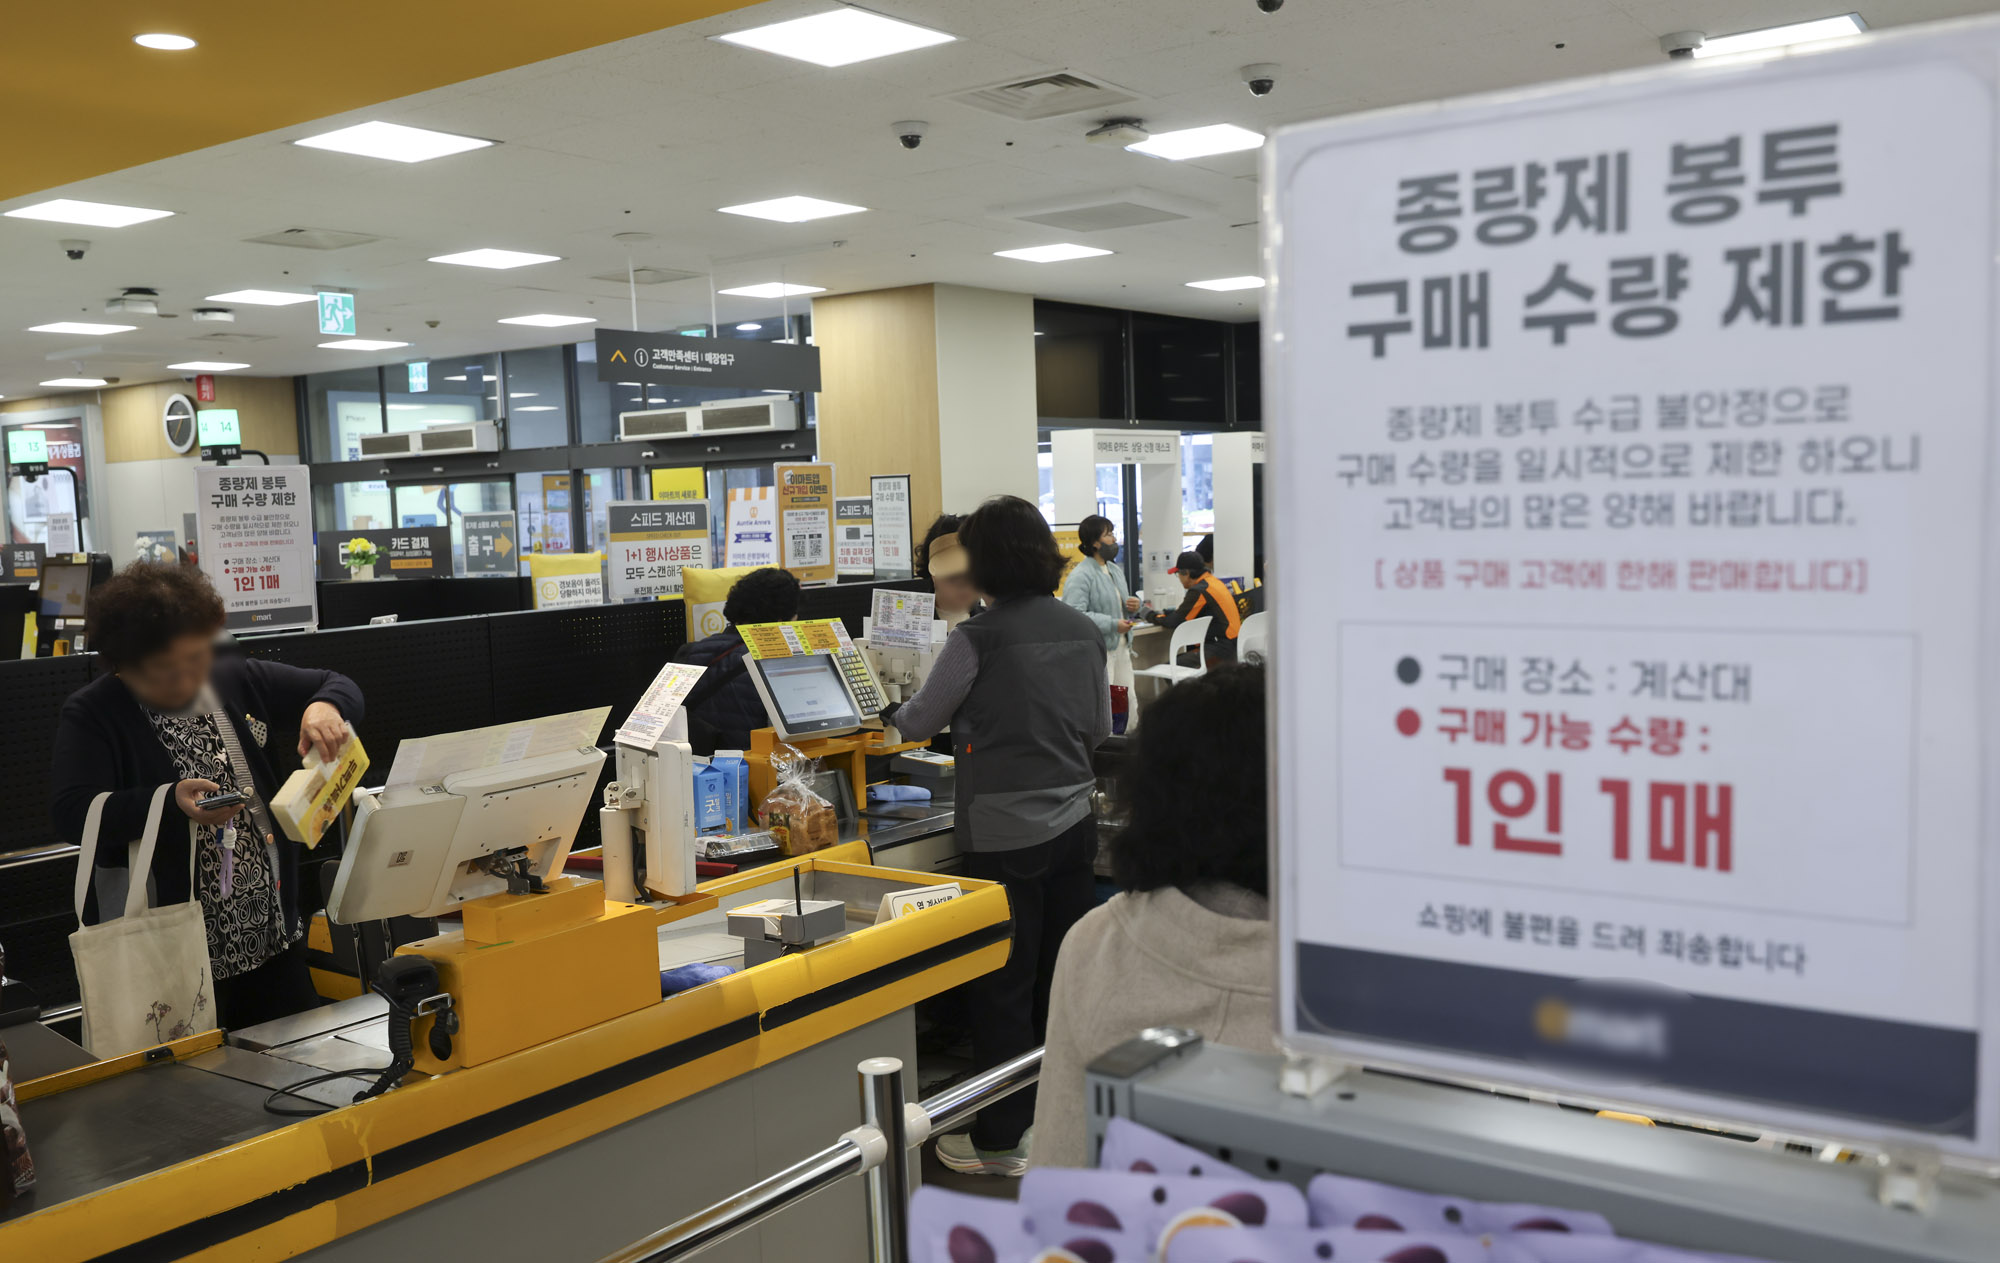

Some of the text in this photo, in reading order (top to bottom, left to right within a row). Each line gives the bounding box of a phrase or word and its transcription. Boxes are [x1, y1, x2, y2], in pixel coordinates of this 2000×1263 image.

[1394, 122, 1845, 256] 종량제 봉투
[1346, 229, 1911, 359] 구매 수량 제한
[705, 352, 735, 366] 매장입구
[1386, 383, 1852, 442] 종량제 봉투 수급 불안정으로
[220, 421, 232, 432] 14
[1336, 433, 1921, 488] 구매 수량을 일시적으로 제한 하오니
[219, 475, 287, 491] 종량제 봉투
[211, 492, 296, 508] 구매 수량 제한
[862, 505, 872, 516] 계
[1383, 488, 1857, 531] 고객님의 많은 양해 바랍니다.
[630, 511, 696, 527] 스피드 계산대
[391, 536, 430, 550] 카드 결제
[625, 545, 702, 562] 1+1 행사상품은
[233, 574, 280, 592] 1인 1매
[625, 563, 703, 580] 모두 스캔해주
[1393, 559, 1446, 590] 상품
[1455, 559, 1510, 590] 구매
[1520, 558, 1607, 591] 고객에
[1616, 558, 1678, 592] 한해
[1437, 653, 1507, 694] 구매
[1520, 656, 1594, 697] 장소
[1630, 659, 1753, 704] 계산대
[1437, 706, 1507, 746] 구매
[1520, 711, 1593, 753] 가능
[1607, 715, 1686, 757] 수량
[1442, 766, 1735, 874] 1인 1매
[1418, 902, 1808, 977] 쇼핑에 불편을 드려 죄송합니다
